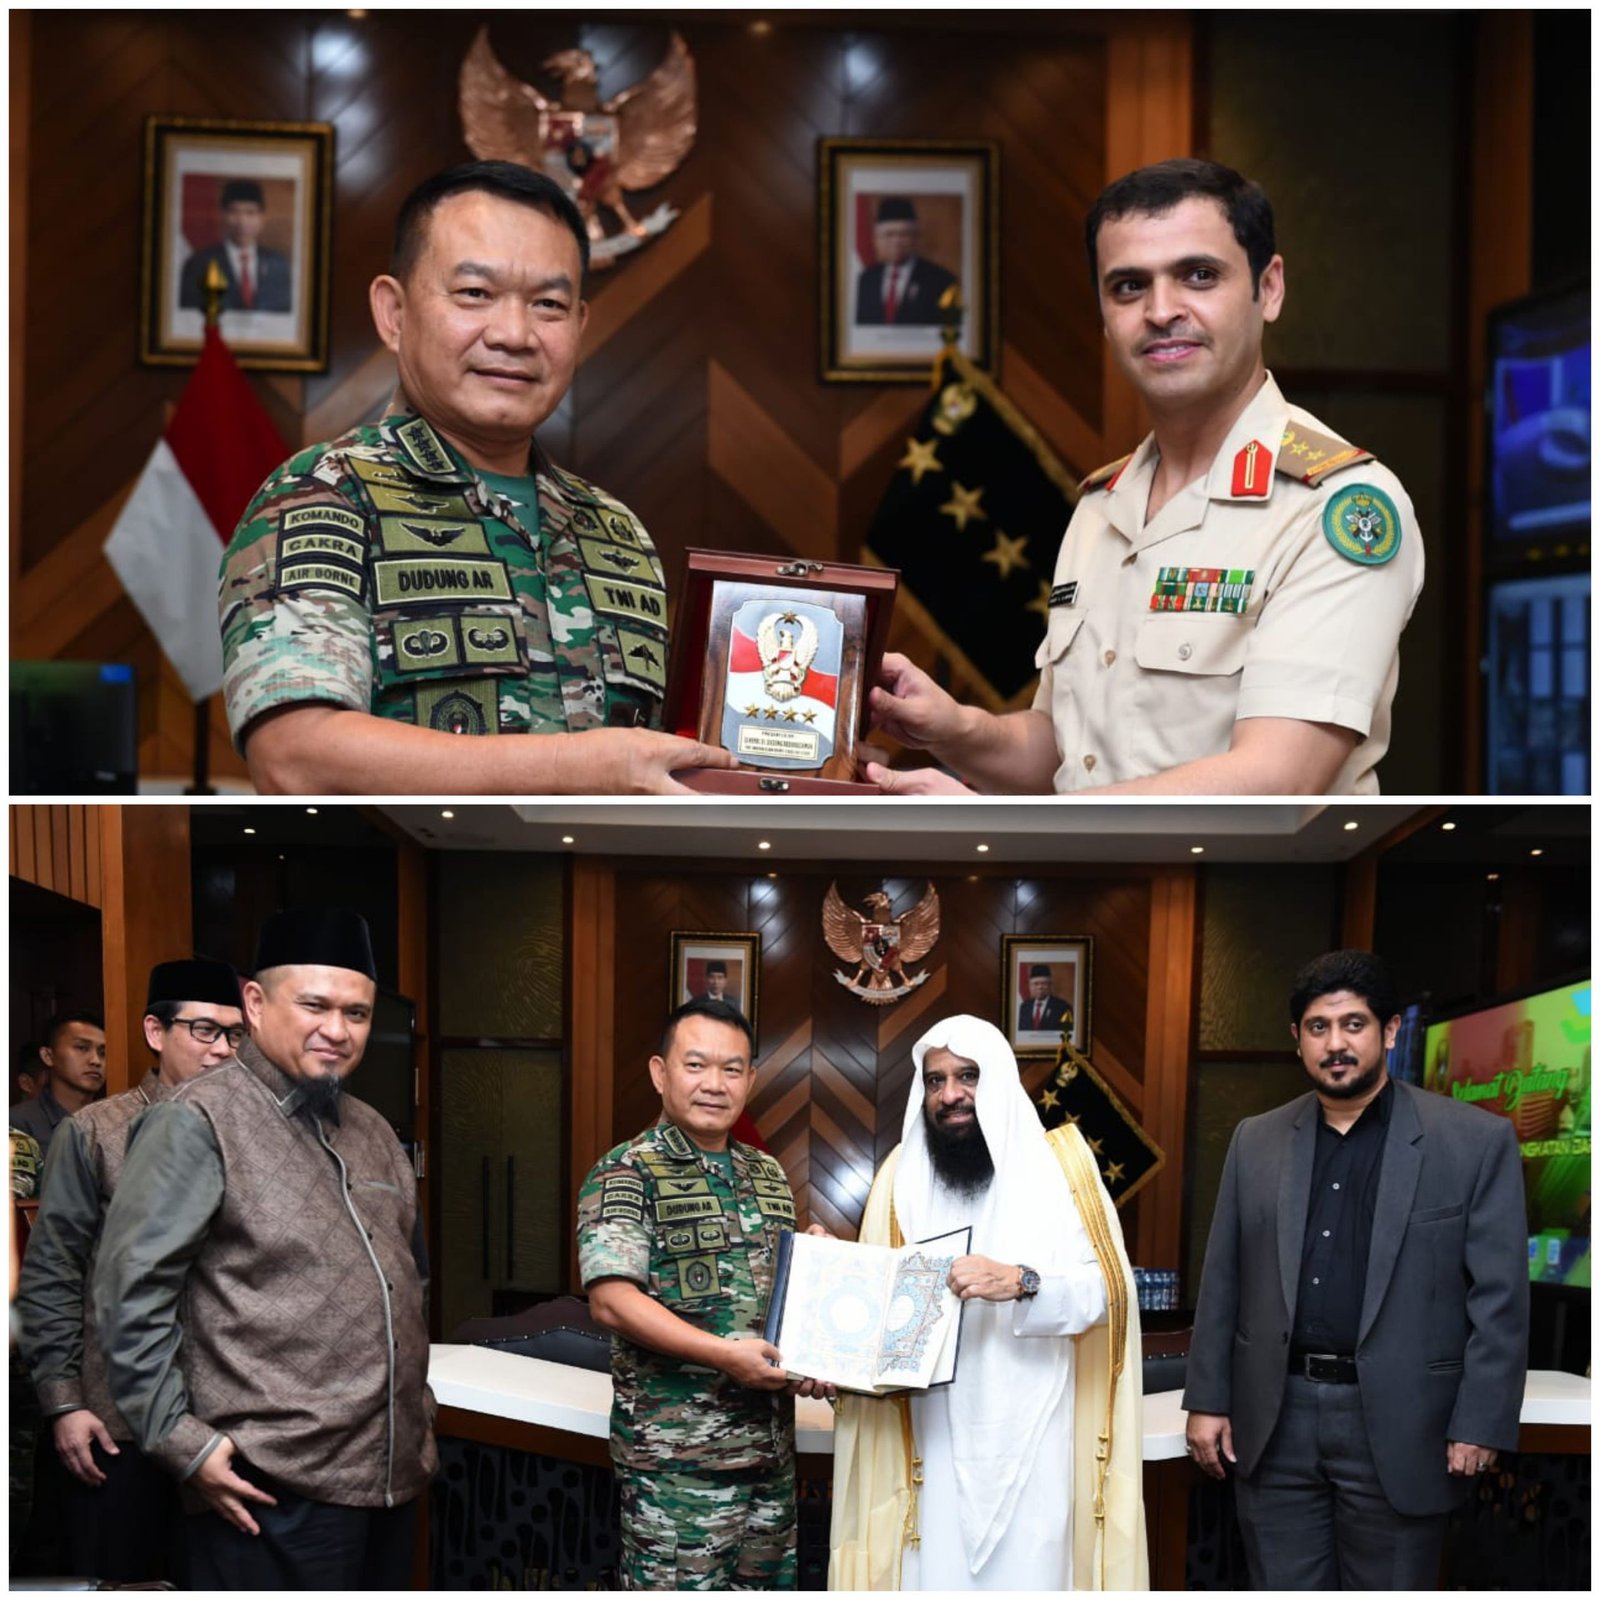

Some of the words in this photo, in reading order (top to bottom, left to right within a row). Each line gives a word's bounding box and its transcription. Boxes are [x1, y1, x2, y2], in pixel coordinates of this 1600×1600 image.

[291, 511, 359, 529] KOMANDO
[289, 538, 357, 557] CAKRA
[288, 568, 309, 581] AIR
[314, 567, 356, 588] BORNE
[398, 569, 469, 591] DUDUNG
[472, 570, 493, 590] AR
[603, 587, 636, 609] TNI
[640, 597, 661, 617] AD
[1504, 1062, 1569, 1112] Datang
[608, 1178, 642, 1189] KOMANDO
[606, 1192, 641, 1203] CAKRA
[666, 1202, 700, 1216] DUDUNG
[701, 1201, 713, 1212] AR
[767, 1202, 782, 1212] TNI
[783, 1204, 792, 1215] AD
